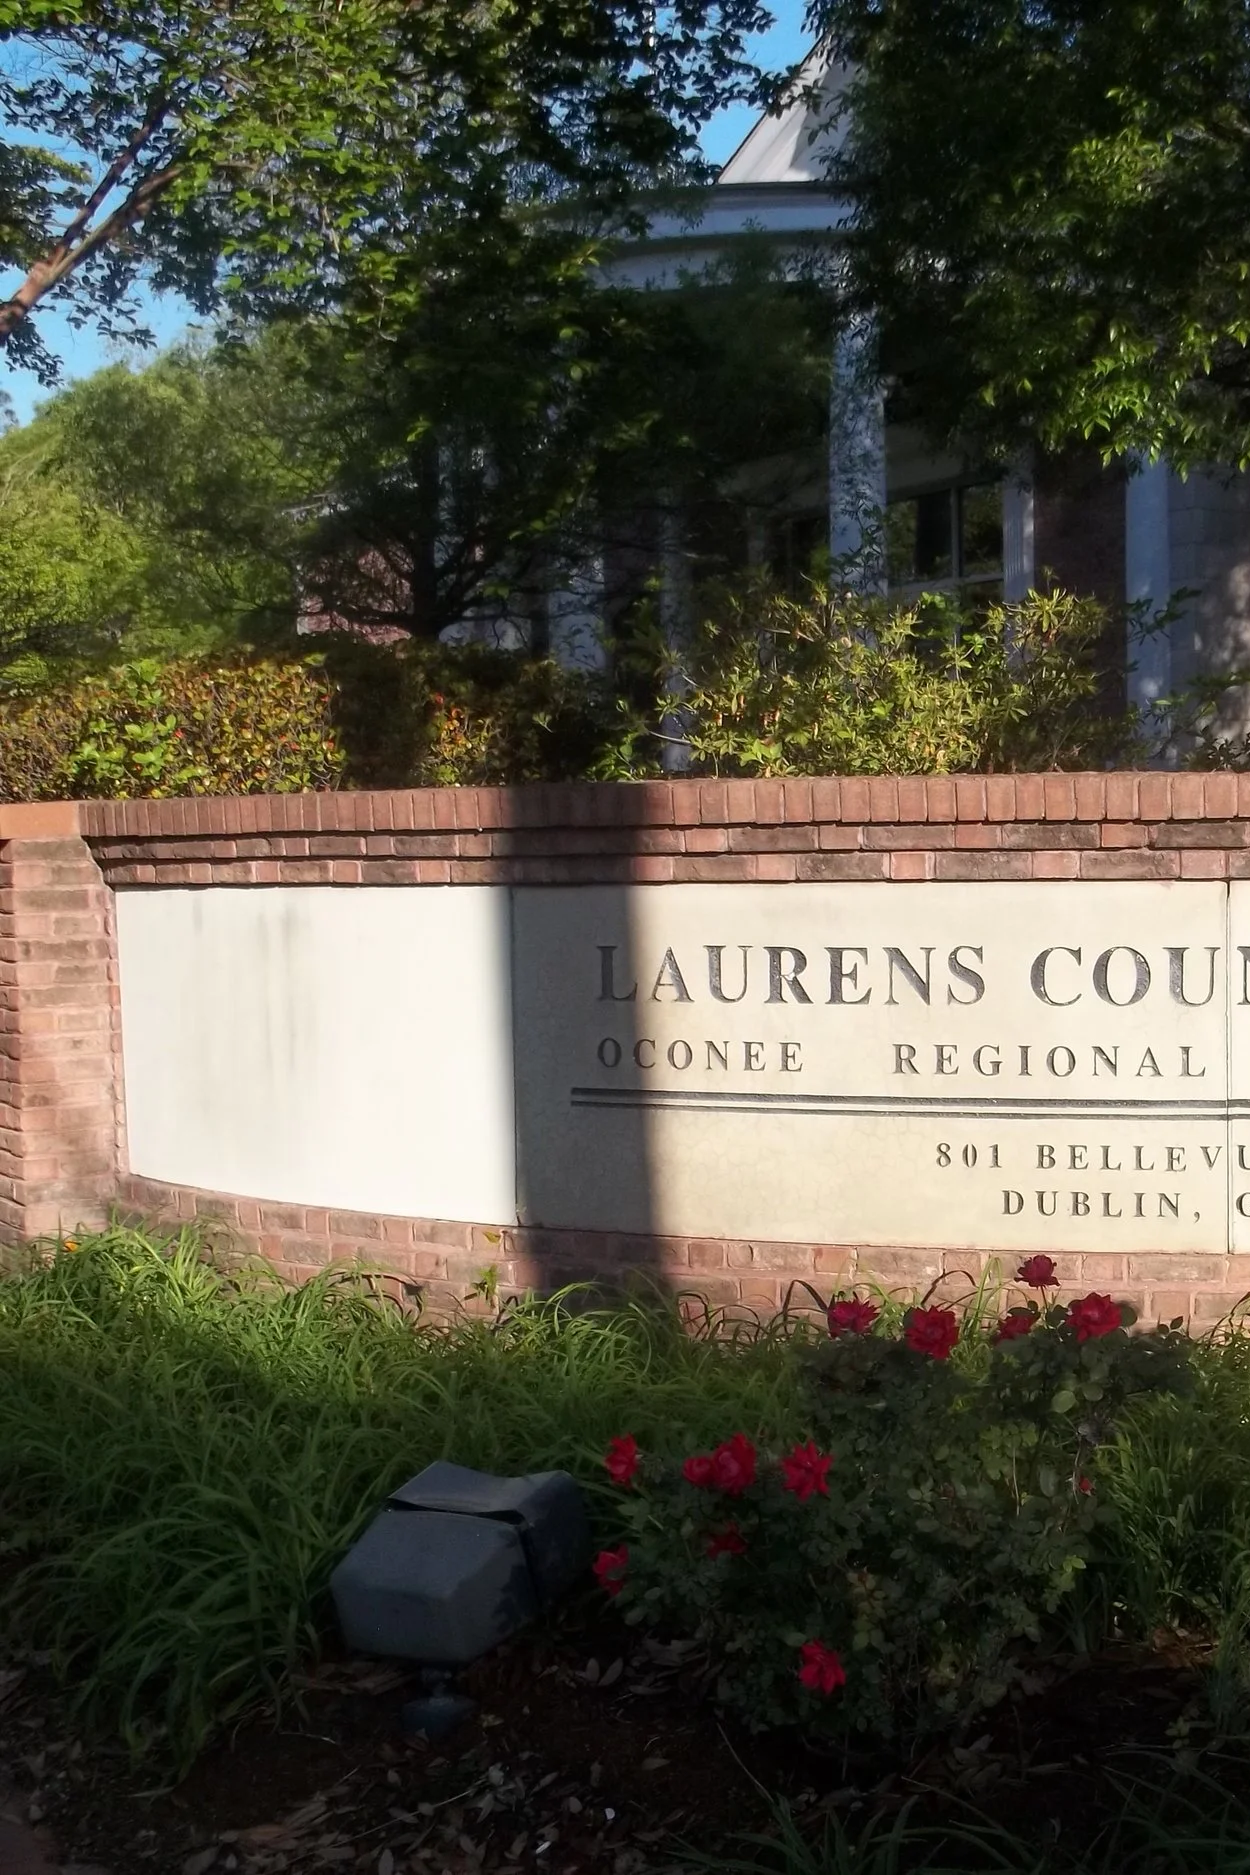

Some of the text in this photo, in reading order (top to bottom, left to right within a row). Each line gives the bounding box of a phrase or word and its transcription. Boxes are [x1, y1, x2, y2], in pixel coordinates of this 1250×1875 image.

[596, 945, 986, 1005] LAURENS
[597, 1037, 804, 1072] OCONEE
[893, 1044, 1207, 1078] REGIONAL
[936, 1143, 1002, 1169] 801
[1002, 1190, 1201, 1222] DUBLIN,
